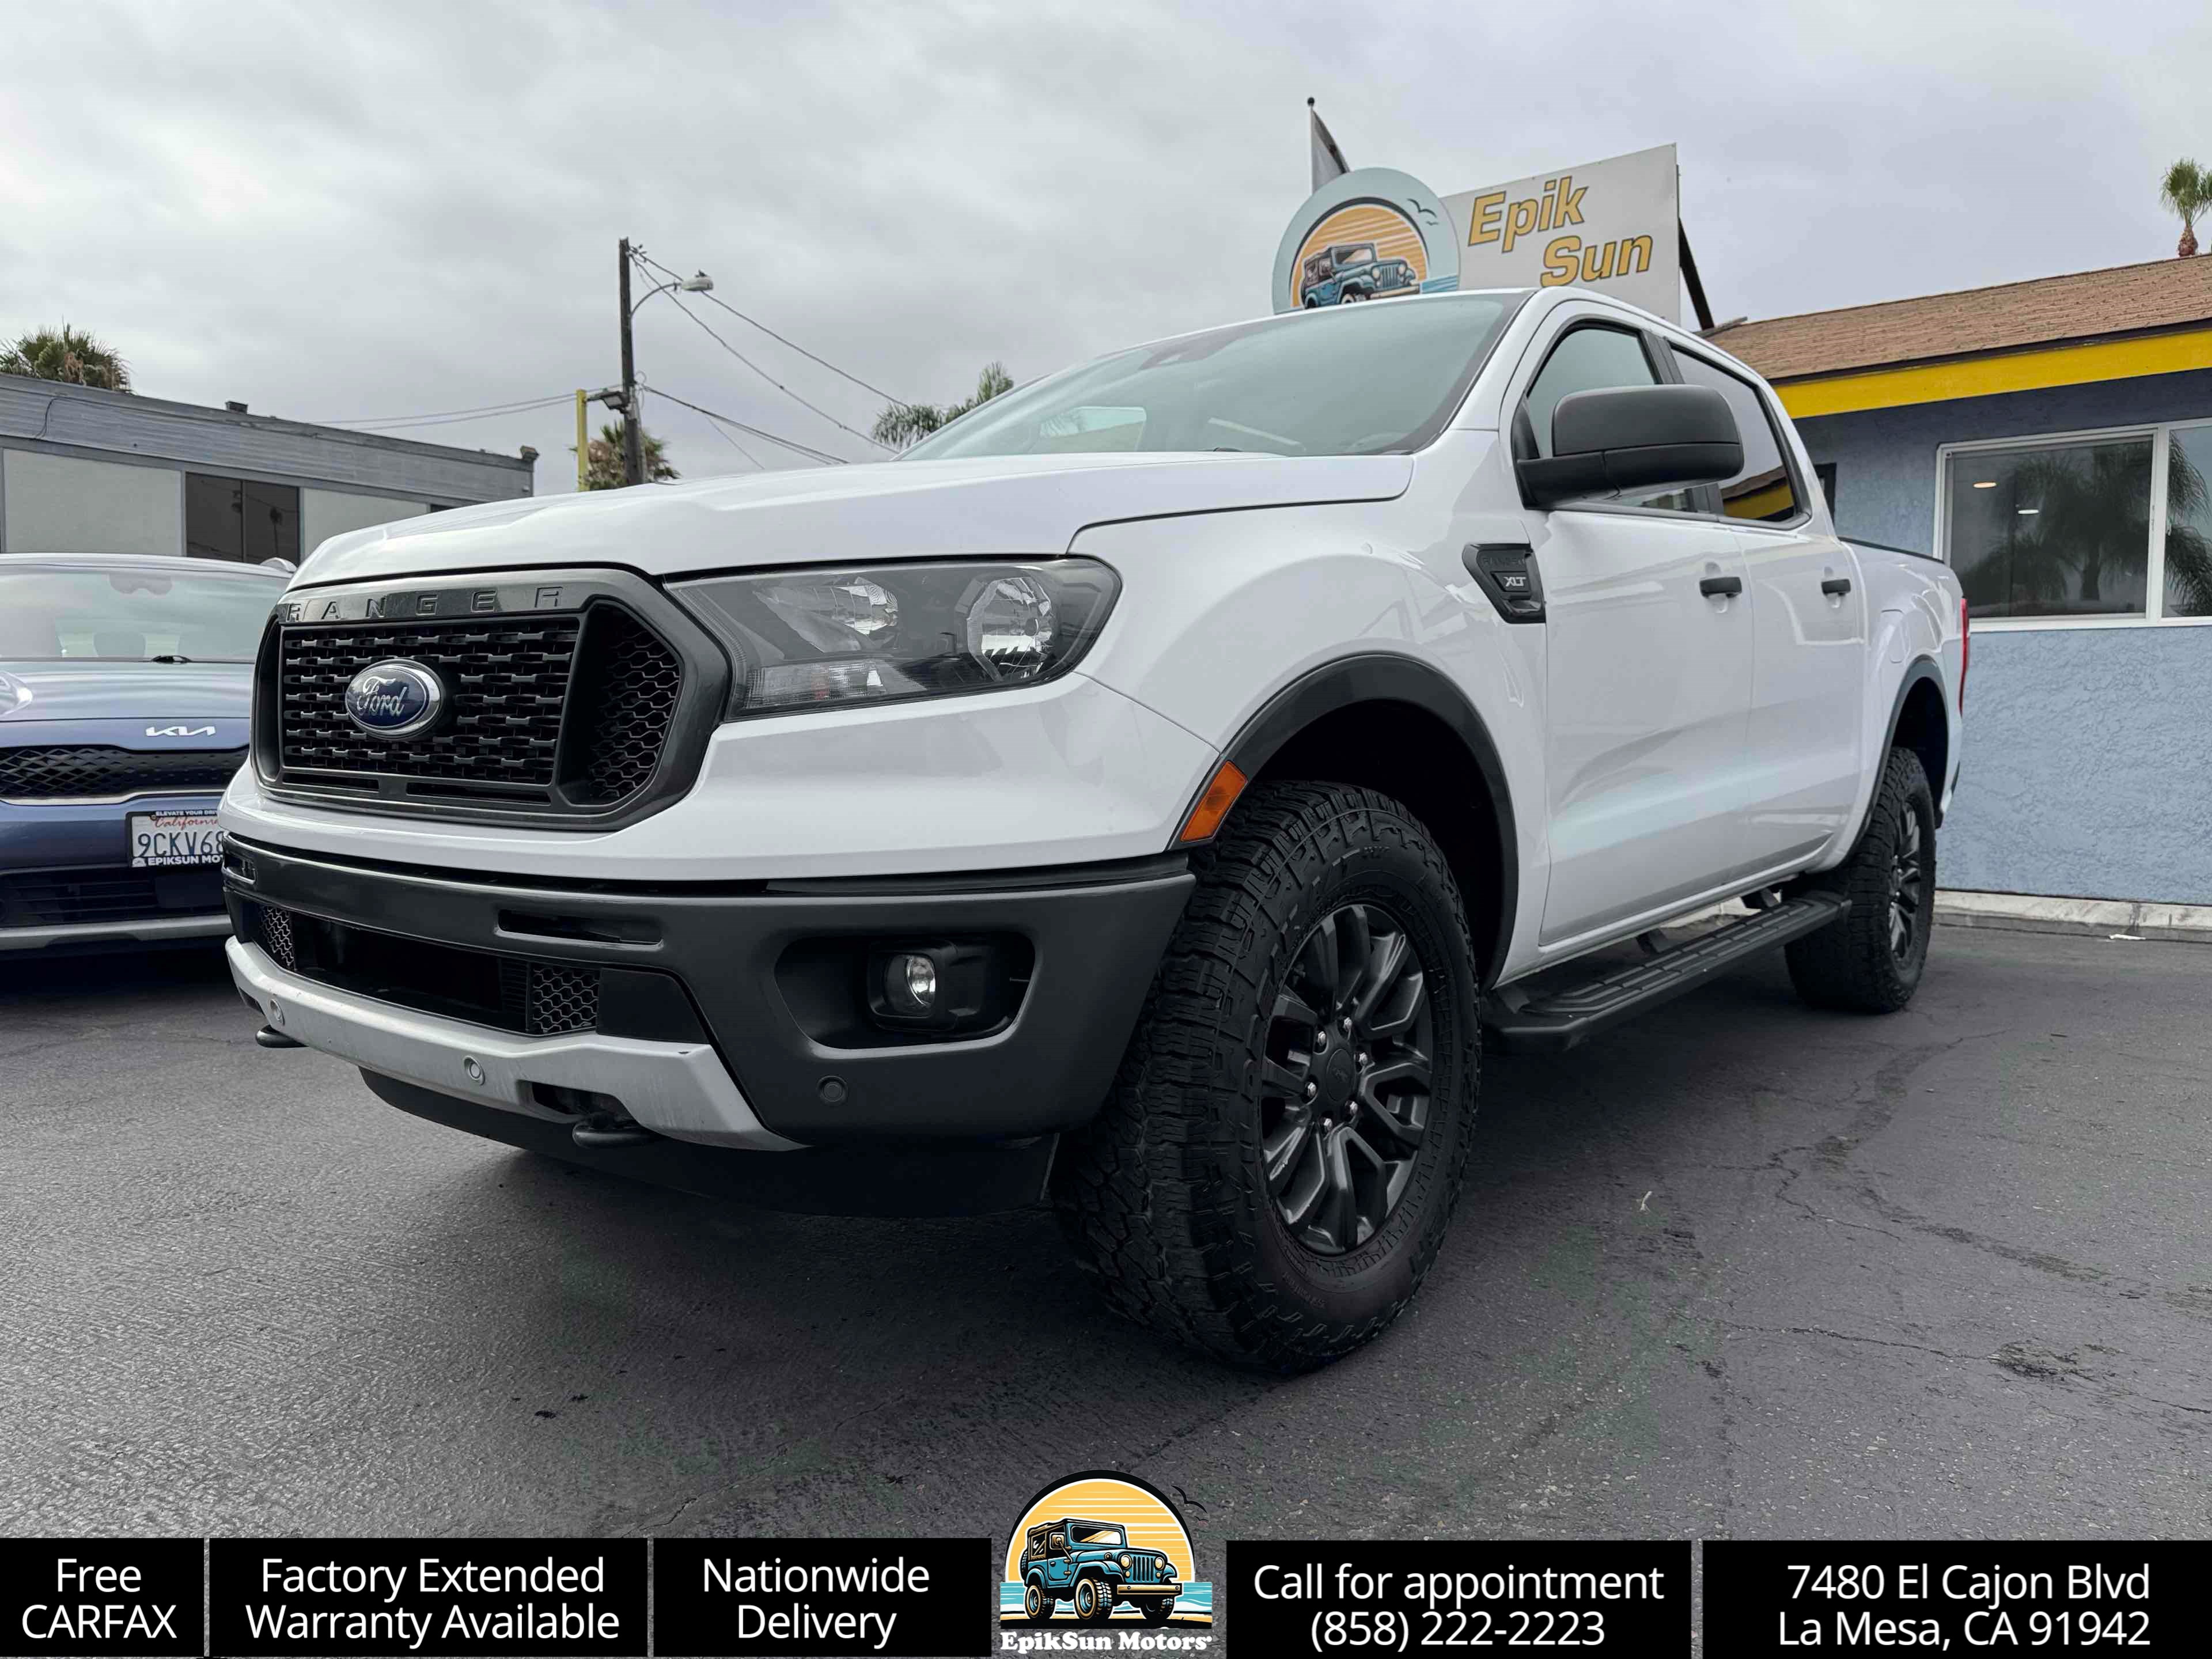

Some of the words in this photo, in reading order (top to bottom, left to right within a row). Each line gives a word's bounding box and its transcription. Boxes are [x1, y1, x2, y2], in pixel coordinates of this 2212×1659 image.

[1468, 175, 1589, 253] Epik
[1540, 234, 1653, 288] Sun
[1503, 577, 1526, 586] XLT
[286, 586, 563, 622] RANGER
[357, 676, 404, 716] Ford
[146, 726, 216, 737] KIA
[147, 855, 199, 866] EPIKSUN
